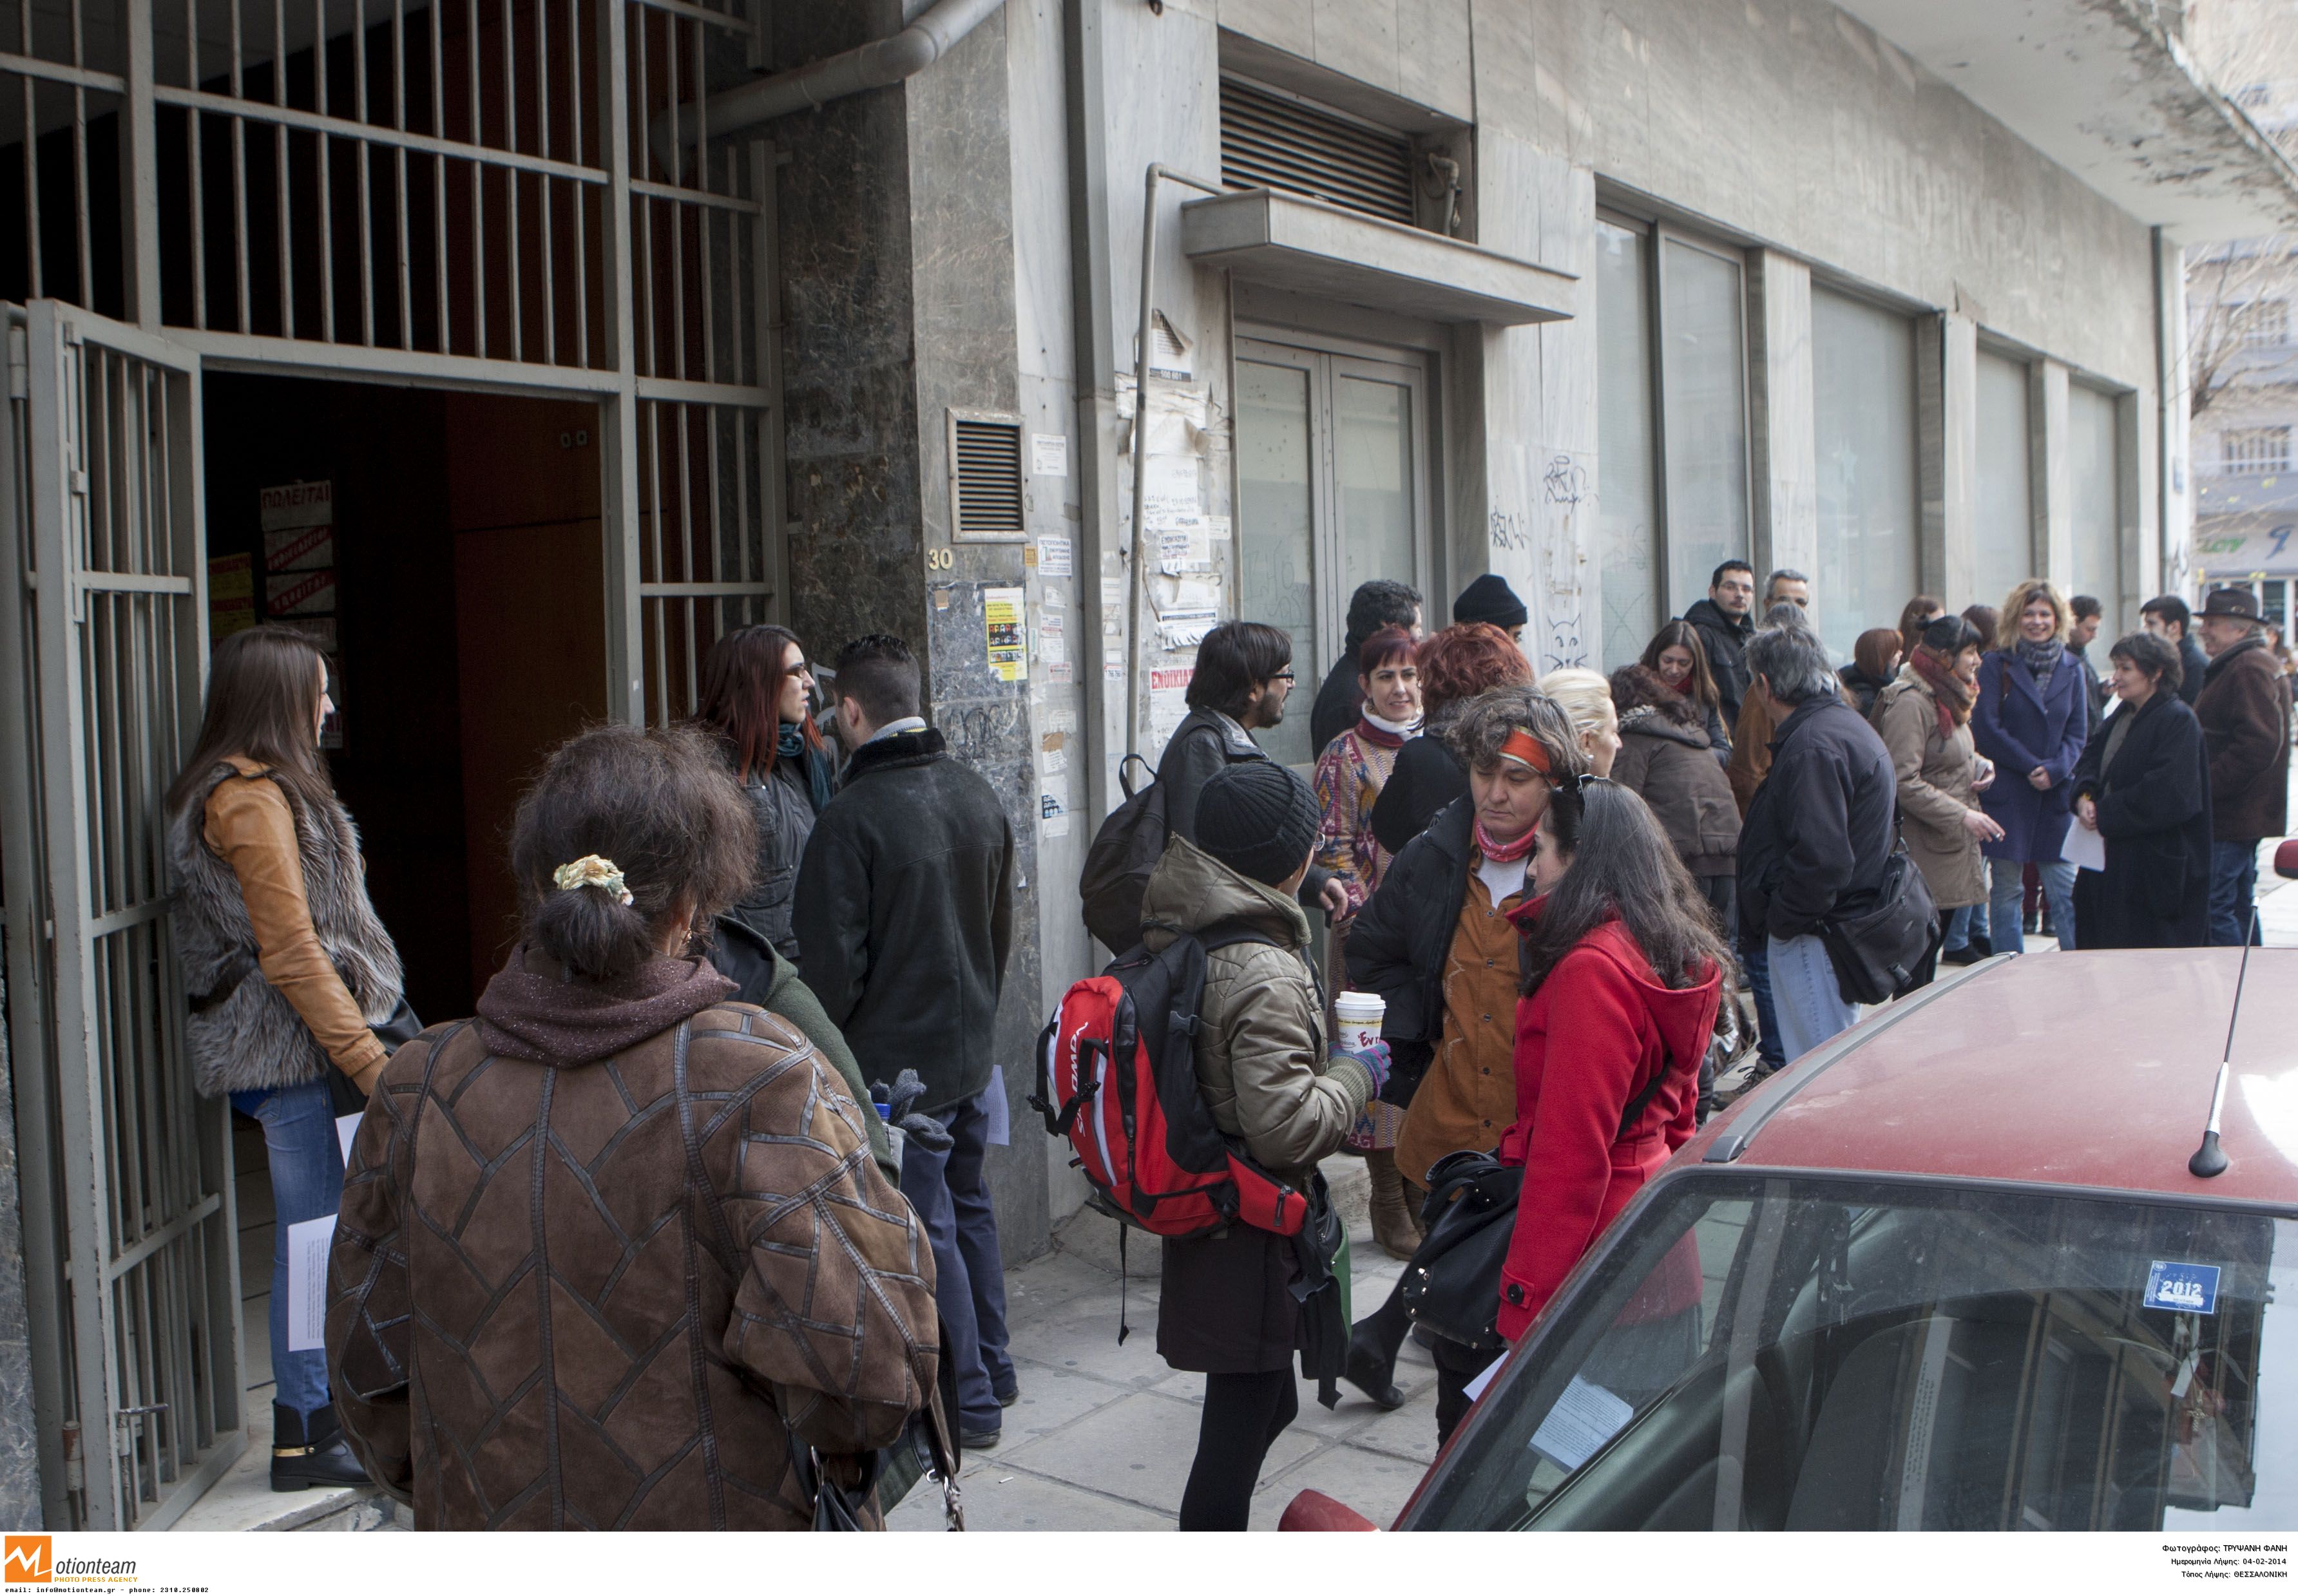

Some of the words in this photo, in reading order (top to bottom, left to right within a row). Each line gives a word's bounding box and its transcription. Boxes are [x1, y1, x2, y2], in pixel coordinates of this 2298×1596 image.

[262, 484, 329, 508] ΠΩΛΕΙΤΑΙ
[928, 547, 953, 570] 30
[2160, 1280, 2203, 1298] 2012
